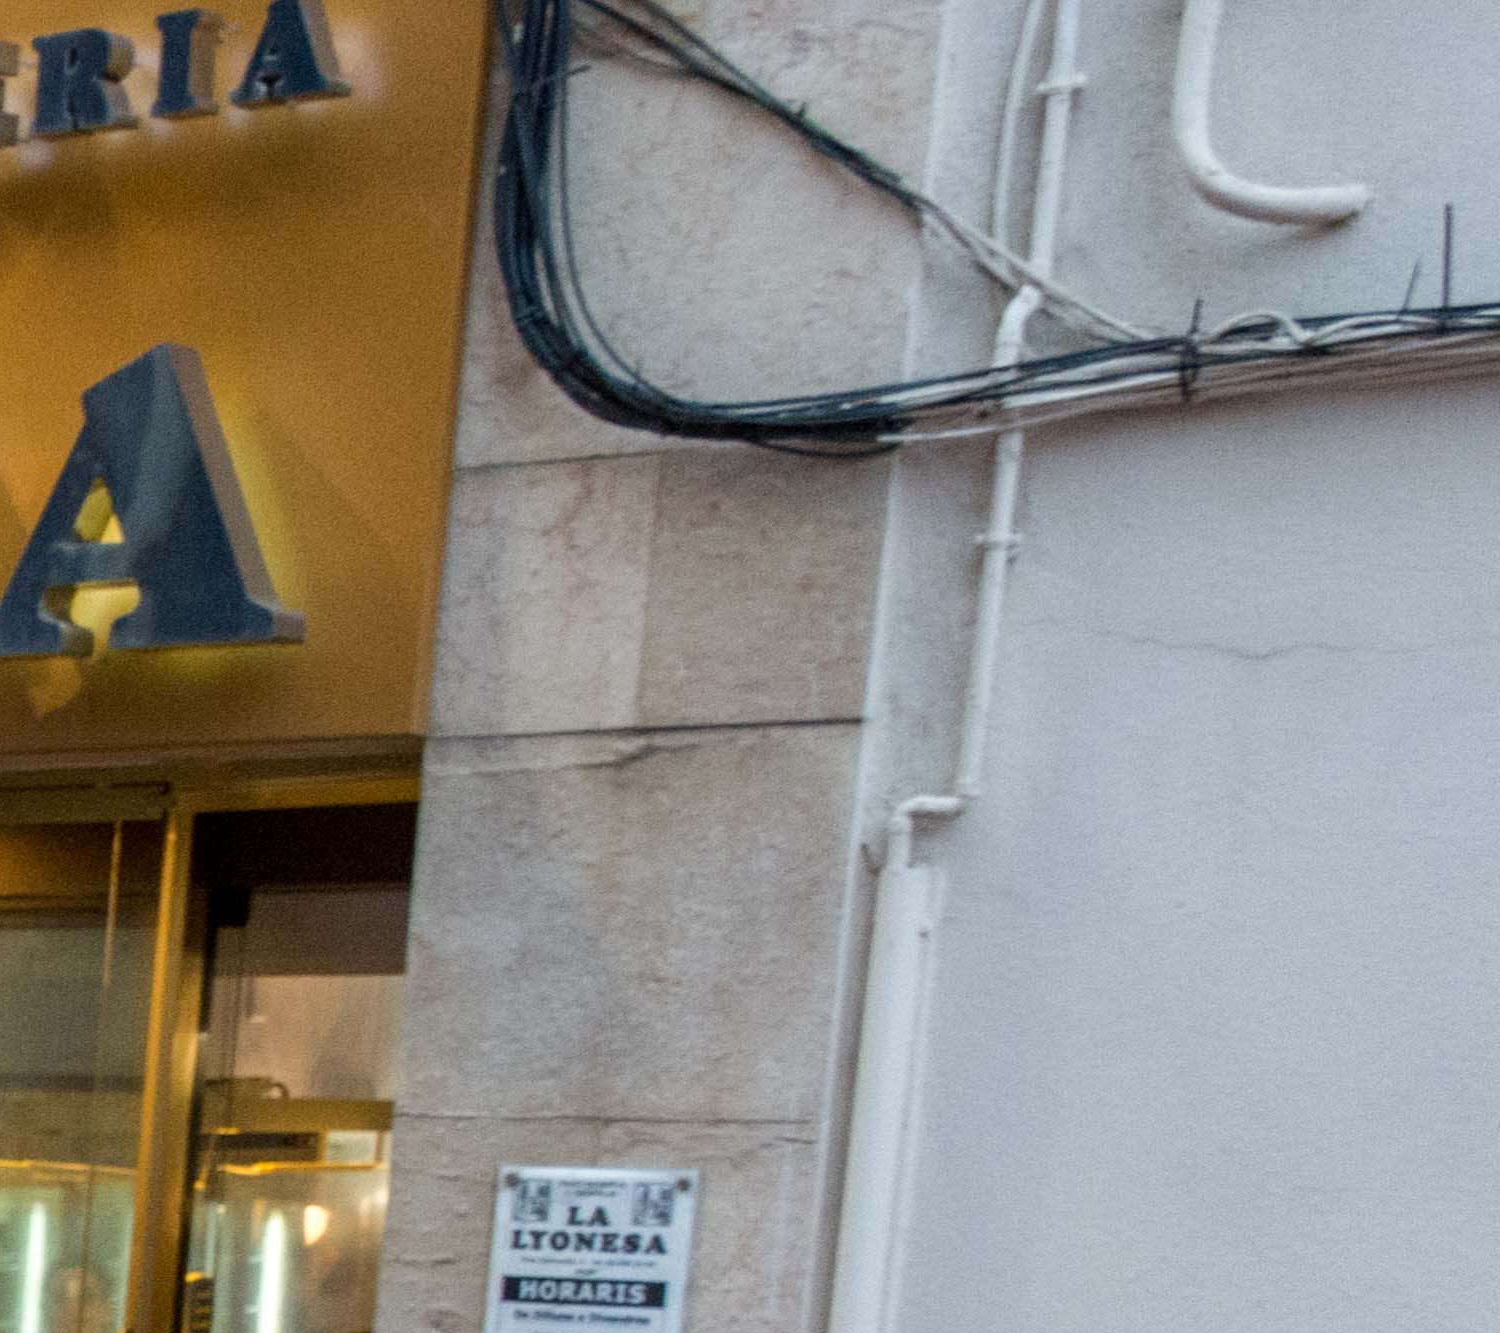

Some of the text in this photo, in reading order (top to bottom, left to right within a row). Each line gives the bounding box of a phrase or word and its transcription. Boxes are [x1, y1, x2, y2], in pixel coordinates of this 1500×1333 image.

[567, 1205, 610, 1228] LA
[511, 1229, 668, 1256] LYONESA
[518, 1280, 647, 1304] HORARIS
